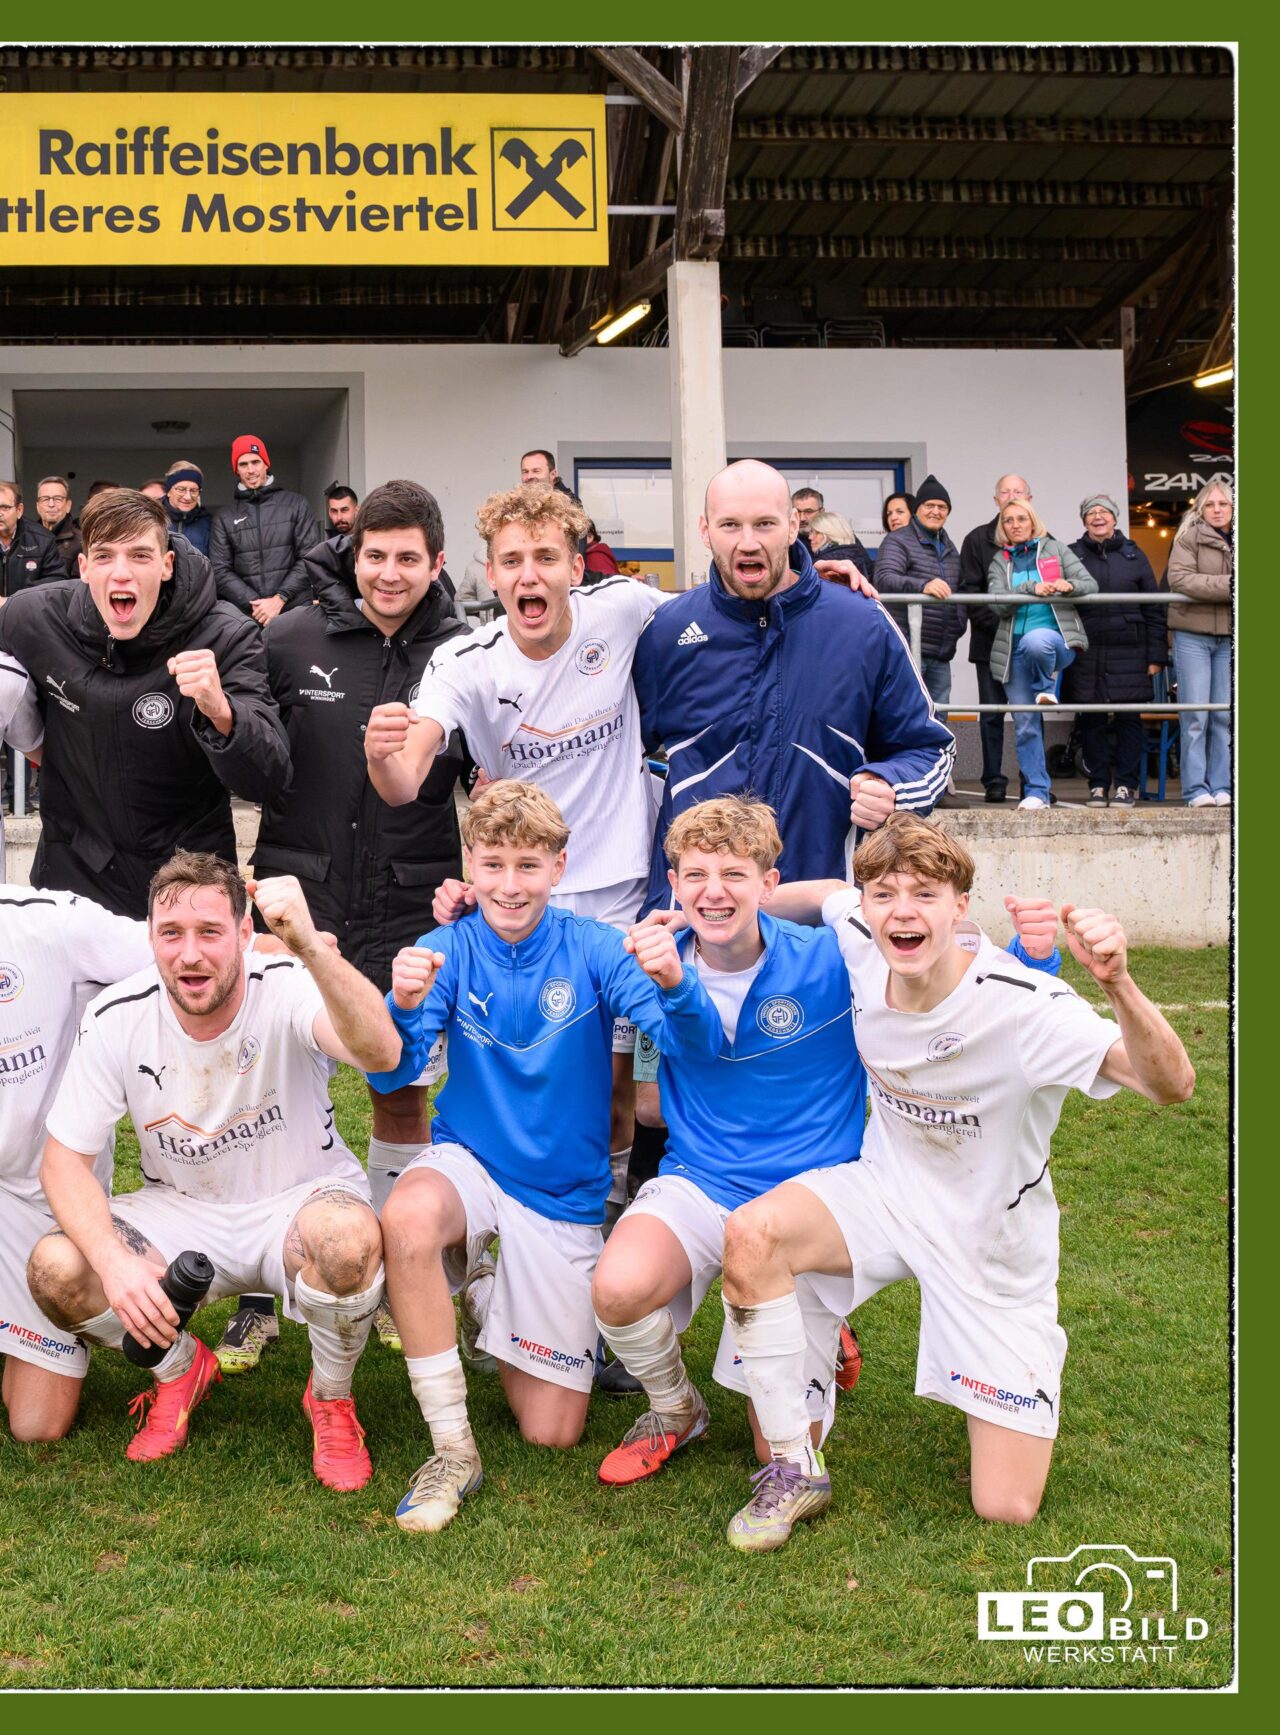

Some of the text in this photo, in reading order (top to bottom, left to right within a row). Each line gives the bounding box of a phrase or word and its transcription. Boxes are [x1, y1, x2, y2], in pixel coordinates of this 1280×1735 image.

[38, 126, 478, 177] Raiffeisenbank
[181, 188, 478, 233] Mostviertel
[677, 634, 709, 646] adidas
[508, 713, 624, 761] Hörmann
[8, 1323, 77, 1356] INTERSPORT
[19, 1338, 60, 1359] WINNINGER
[518, 1338, 586, 1370] INTERSPORT
[529, 1353, 571, 1373] WINNINGER
[961, 1375, 1039, 1410] INTERSPORT
[973, 1391, 1020, 1414] WINNINGER
